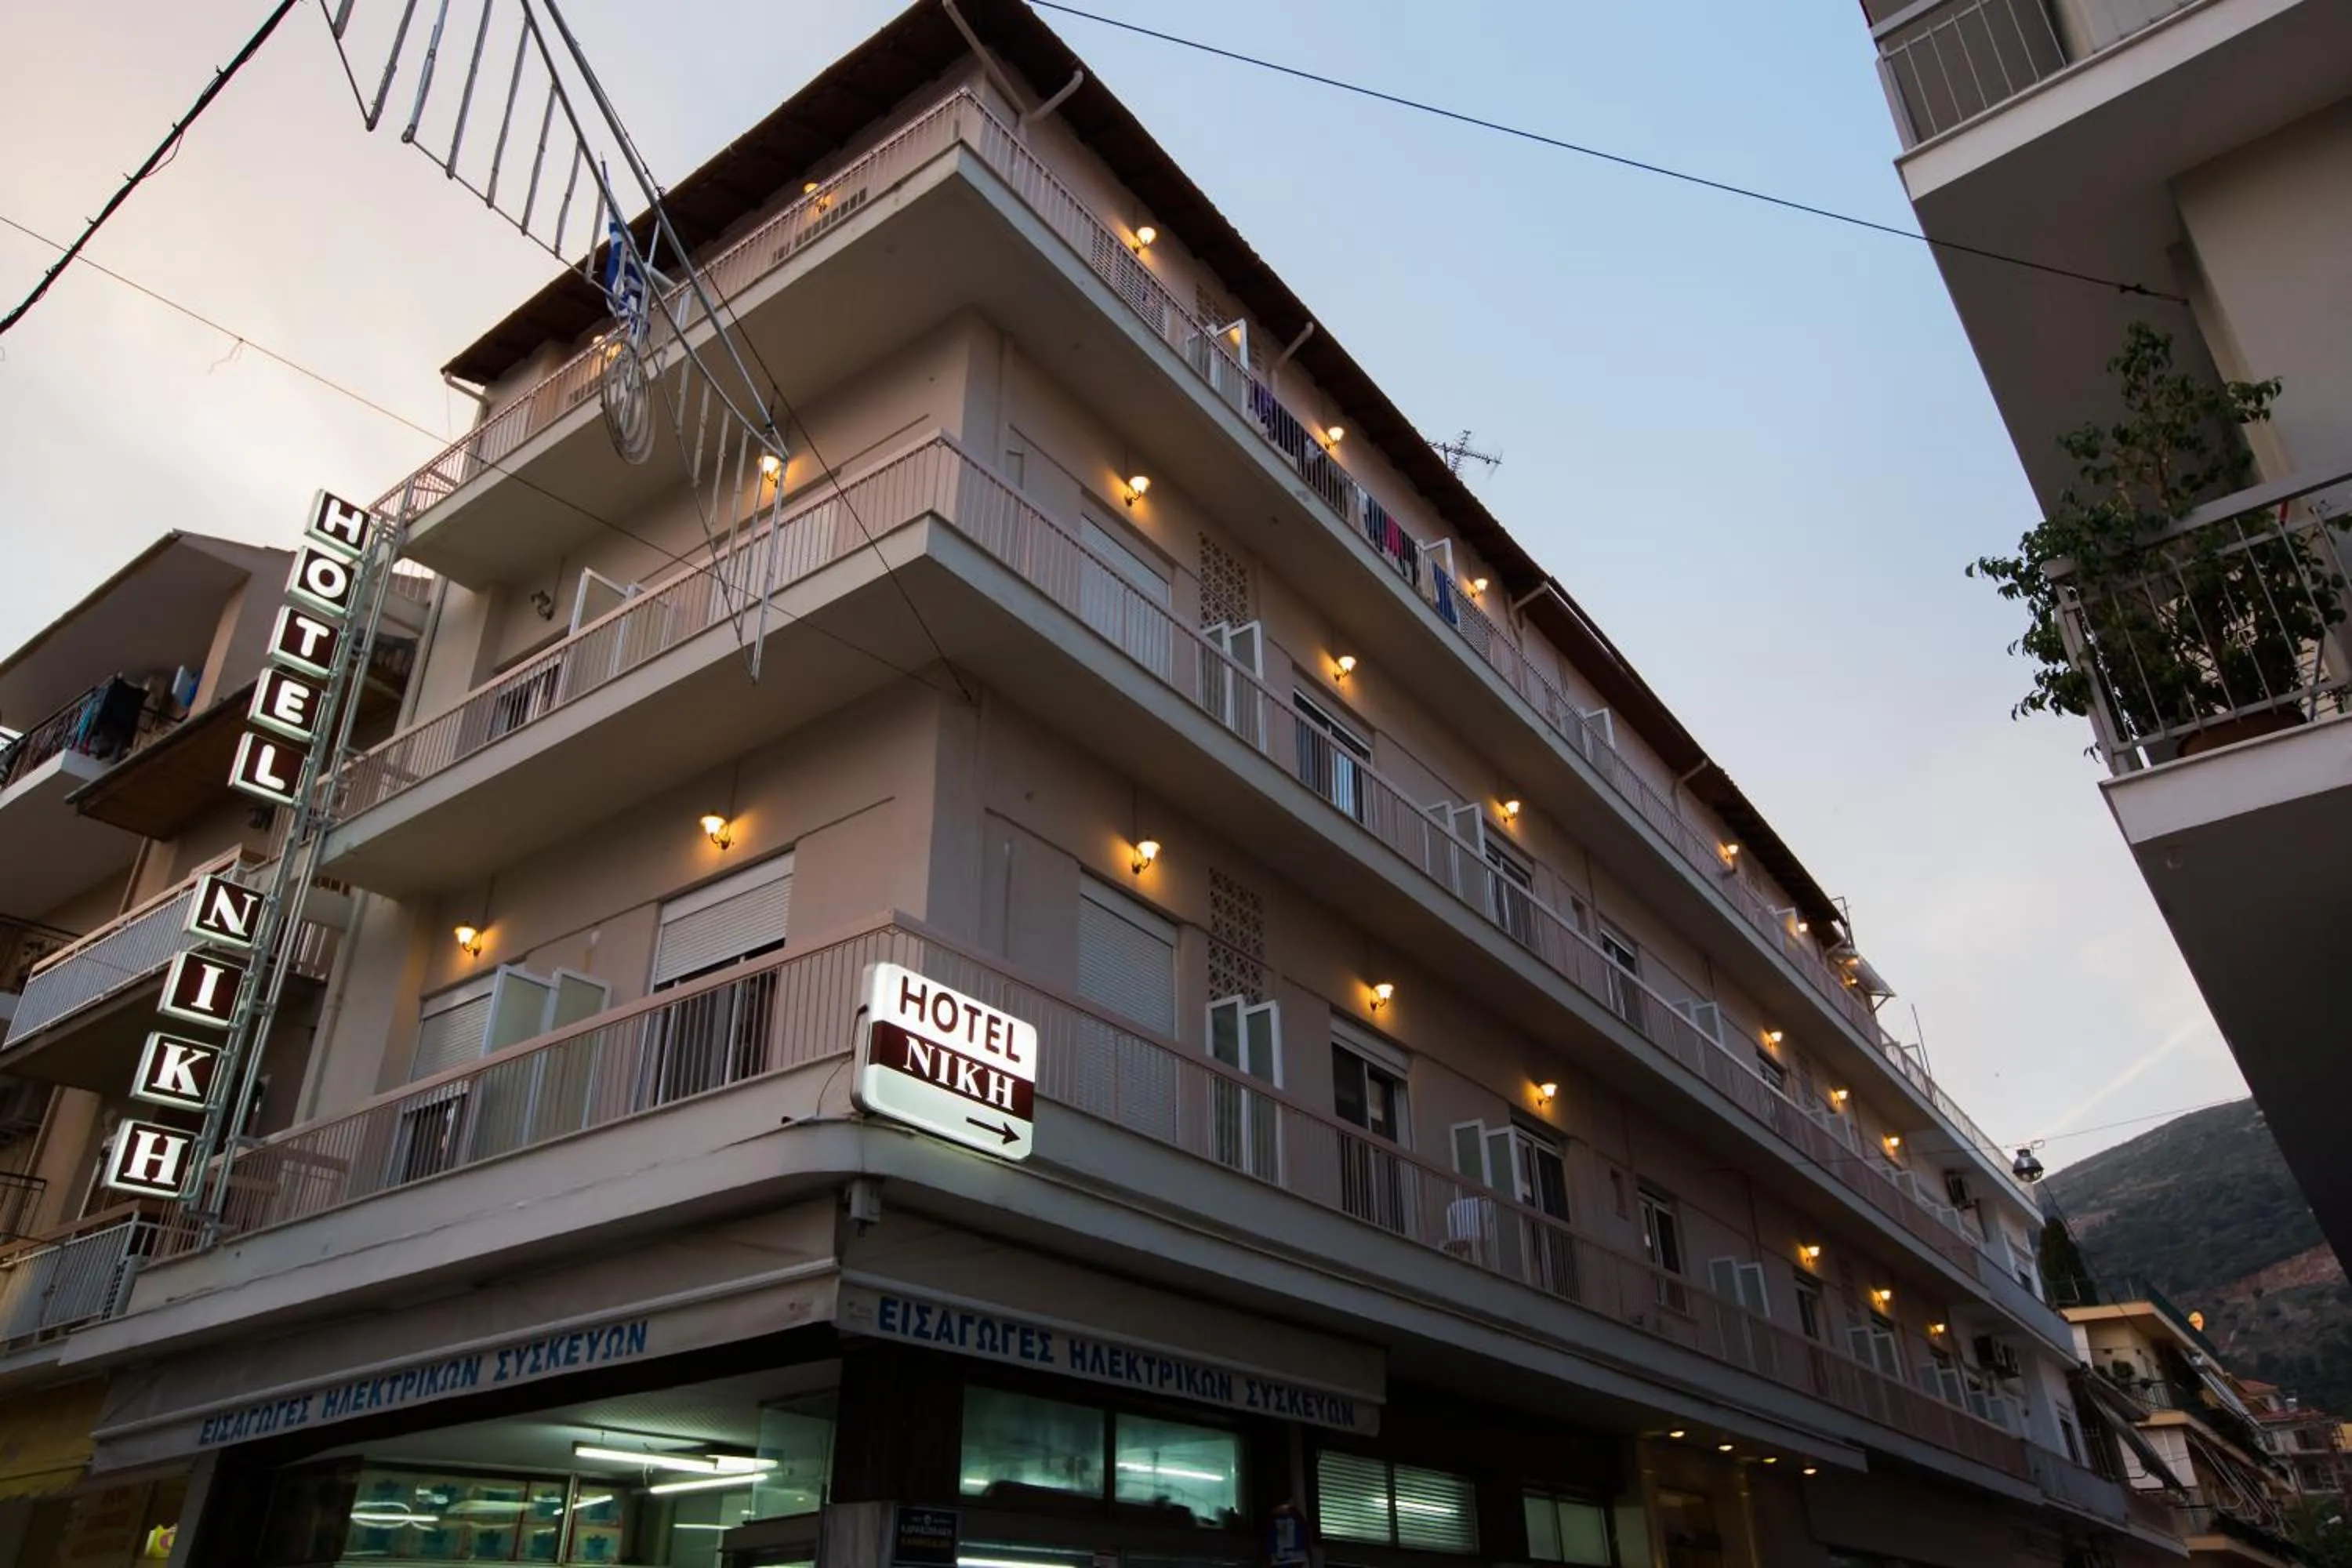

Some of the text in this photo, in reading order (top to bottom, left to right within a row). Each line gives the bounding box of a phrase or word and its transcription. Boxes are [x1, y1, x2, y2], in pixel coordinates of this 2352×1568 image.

[254, 499, 364, 790] HOTEL
[899, 975, 1021, 1063] HOTEL
[198, 1320, 649, 1446] ΕΙΣΑΓΩΓΕΣ ΗΛΕΚΤΡΙΚΩΝ ΣΥΣΚΕΥΩΝ
[878, 1296, 1356, 1427] ΕΙΣΑΓΩΓΕΣ ΗΛΕΚΤΡΙΚΩΝ ΣΥΣΚΕΥΩΝ
